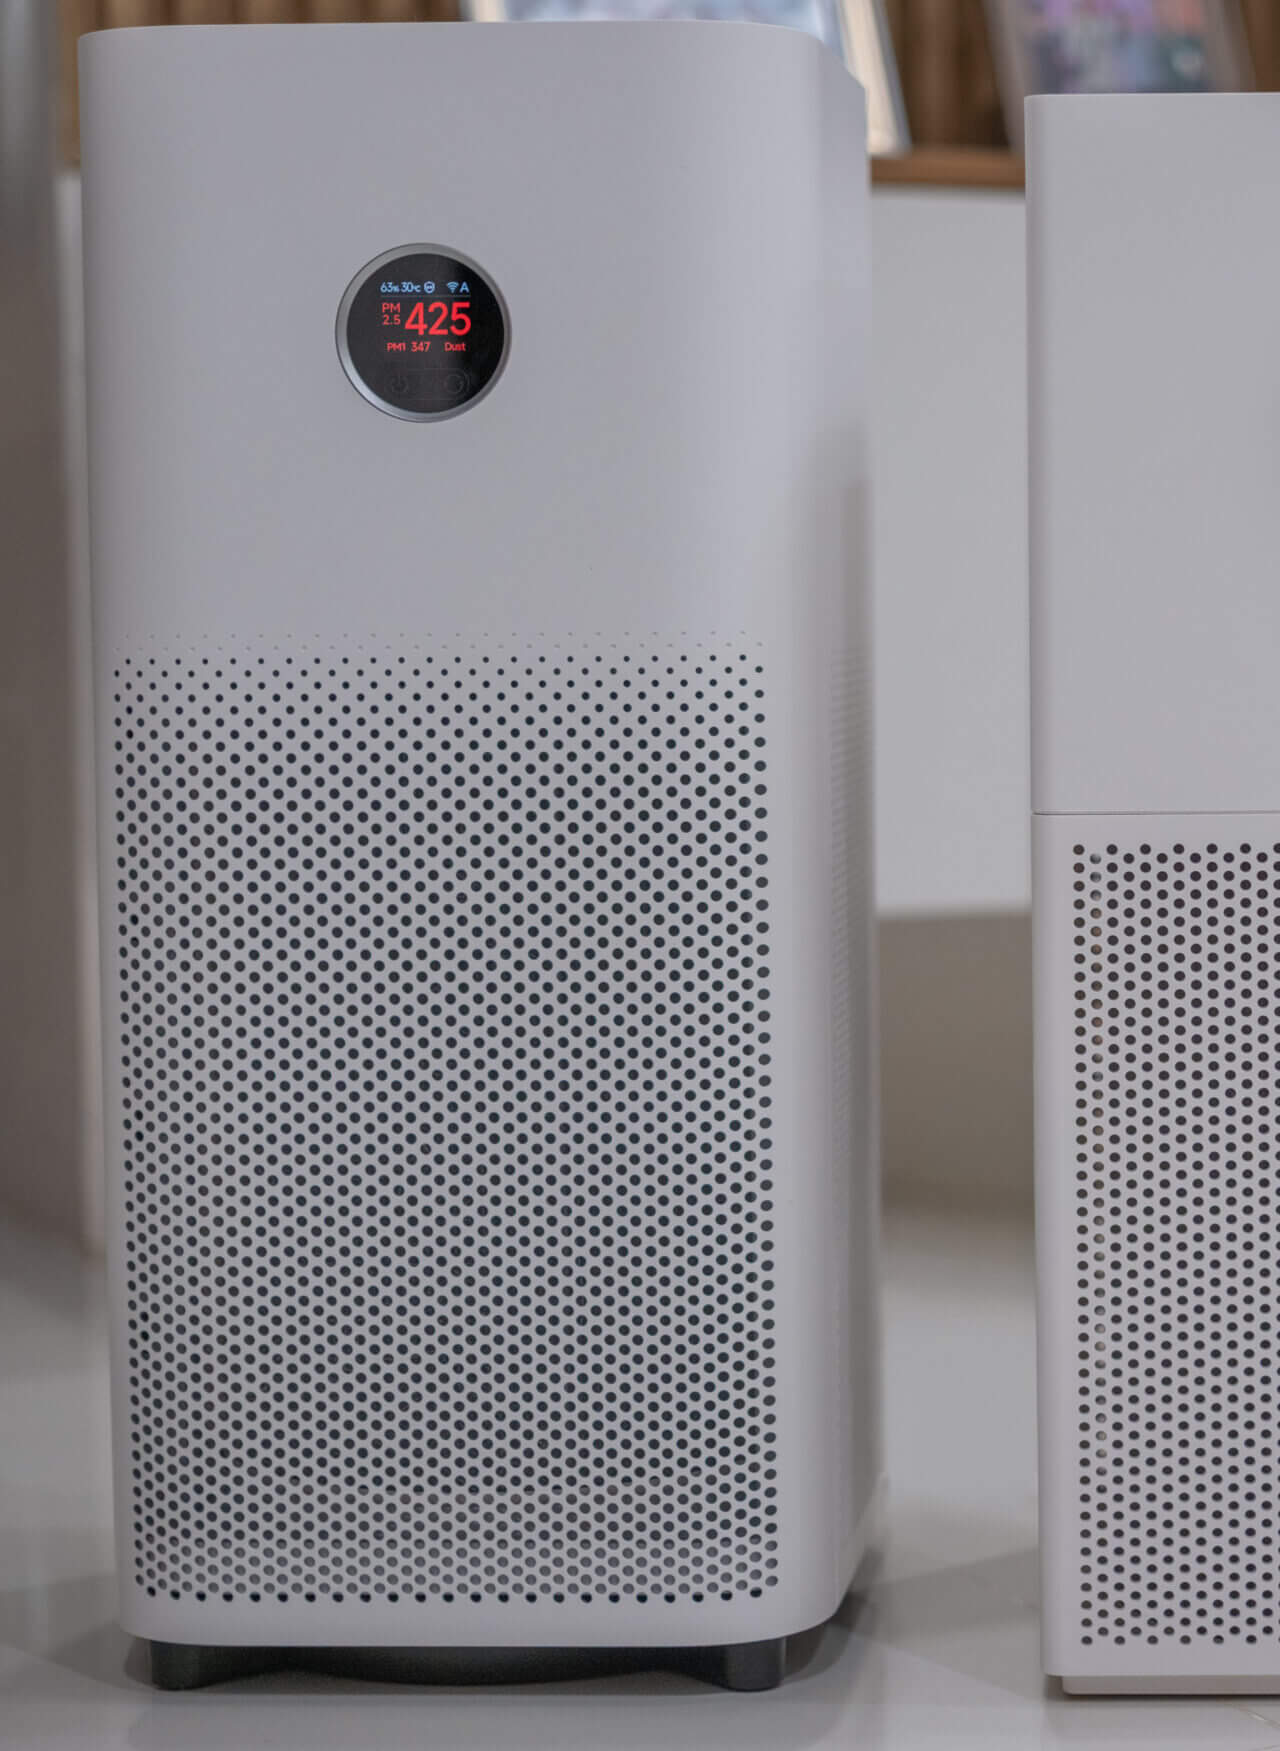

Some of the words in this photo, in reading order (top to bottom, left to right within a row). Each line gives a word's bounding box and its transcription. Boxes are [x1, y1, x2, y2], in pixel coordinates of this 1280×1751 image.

[382, 302, 401, 313] PM
[382, 315, 401, 325] 2.5
[405, 301, 471, 336] 425
[387, 342, 406, 352] PM1
[411, 341, 431, 352] 347
[444, 342, 466, 351] Dust
